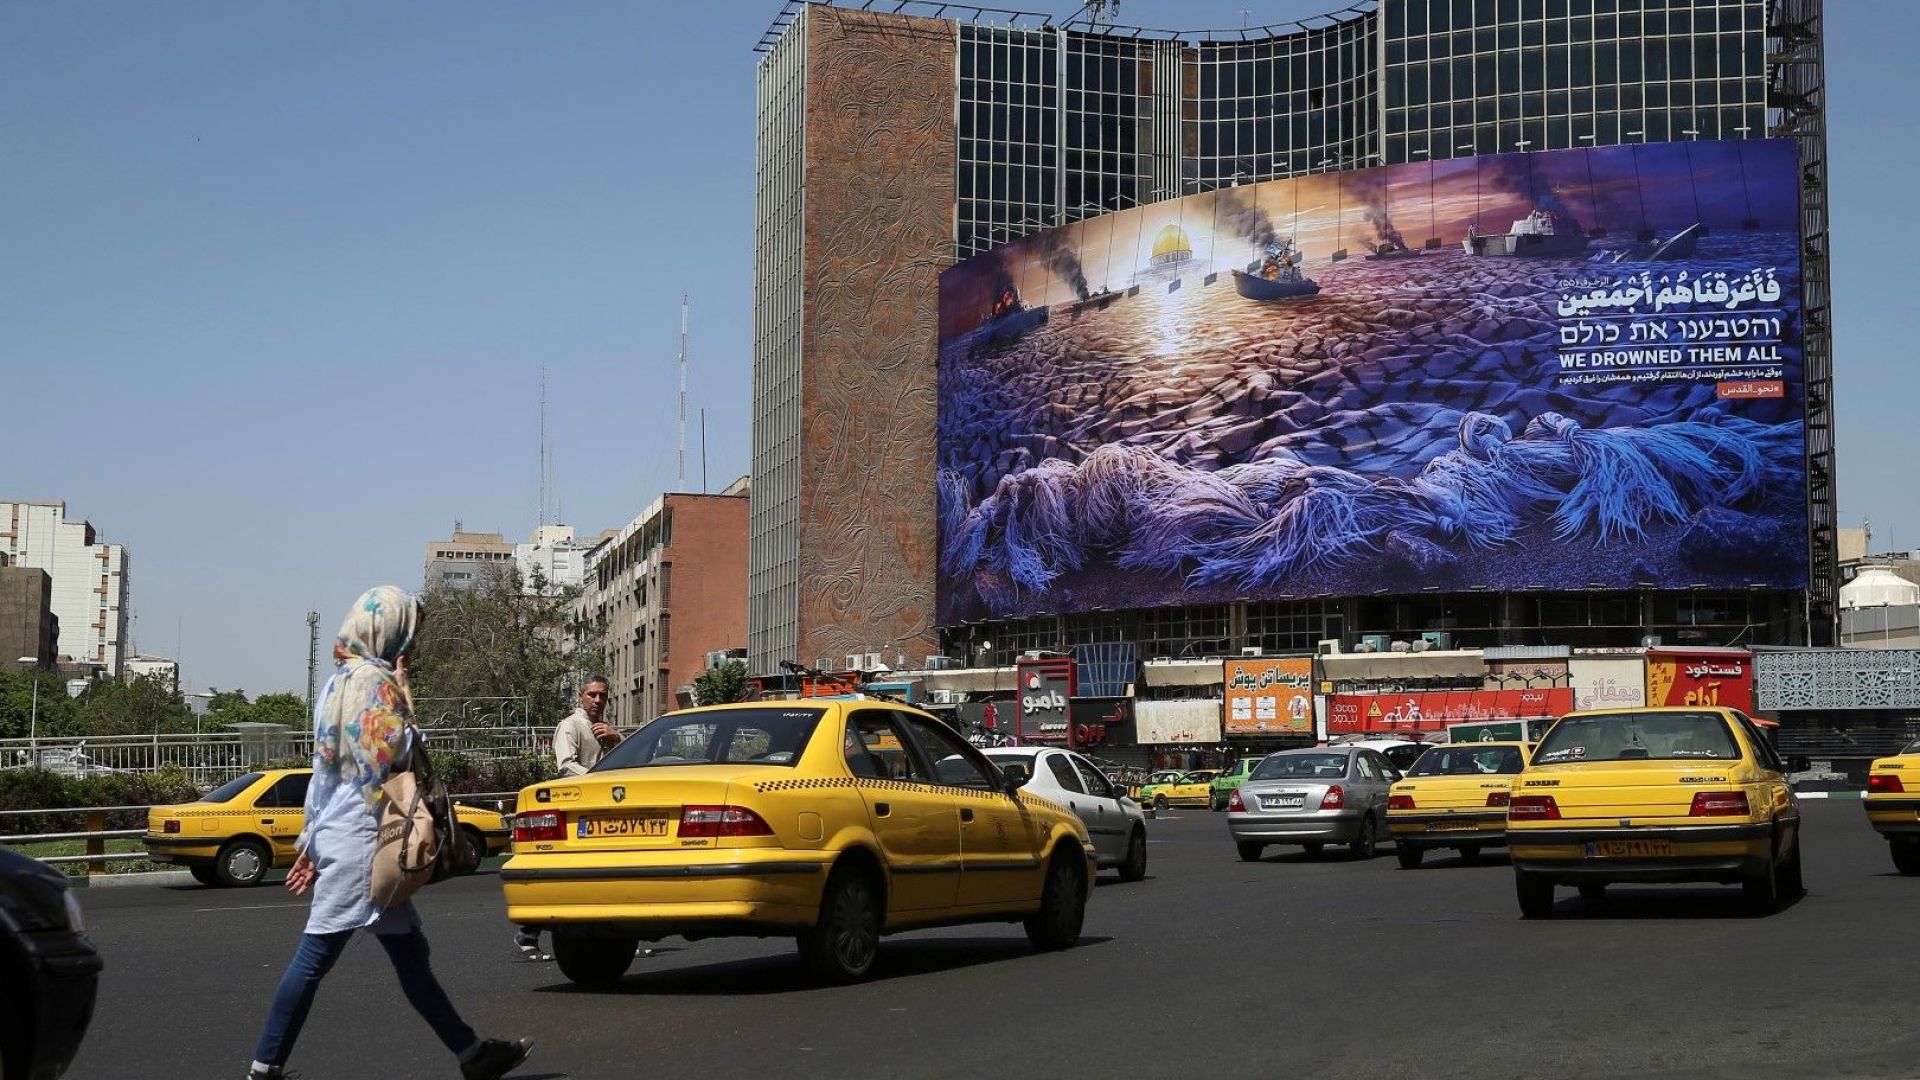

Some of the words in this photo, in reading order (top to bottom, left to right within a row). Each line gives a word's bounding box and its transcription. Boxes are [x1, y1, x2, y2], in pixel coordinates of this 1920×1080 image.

[1559, 319, 1620, 344] כולם
[1629, 320, 1669, 341] את
[1677, 316, 1781, 340] והטבענו
[1559, 353, 1586, 368] WE
[1591, 349, 1682, 367] DROWNED
[1687, 347, 1741, 363] THEM
[1746, 346, 1782, 361] ALL
